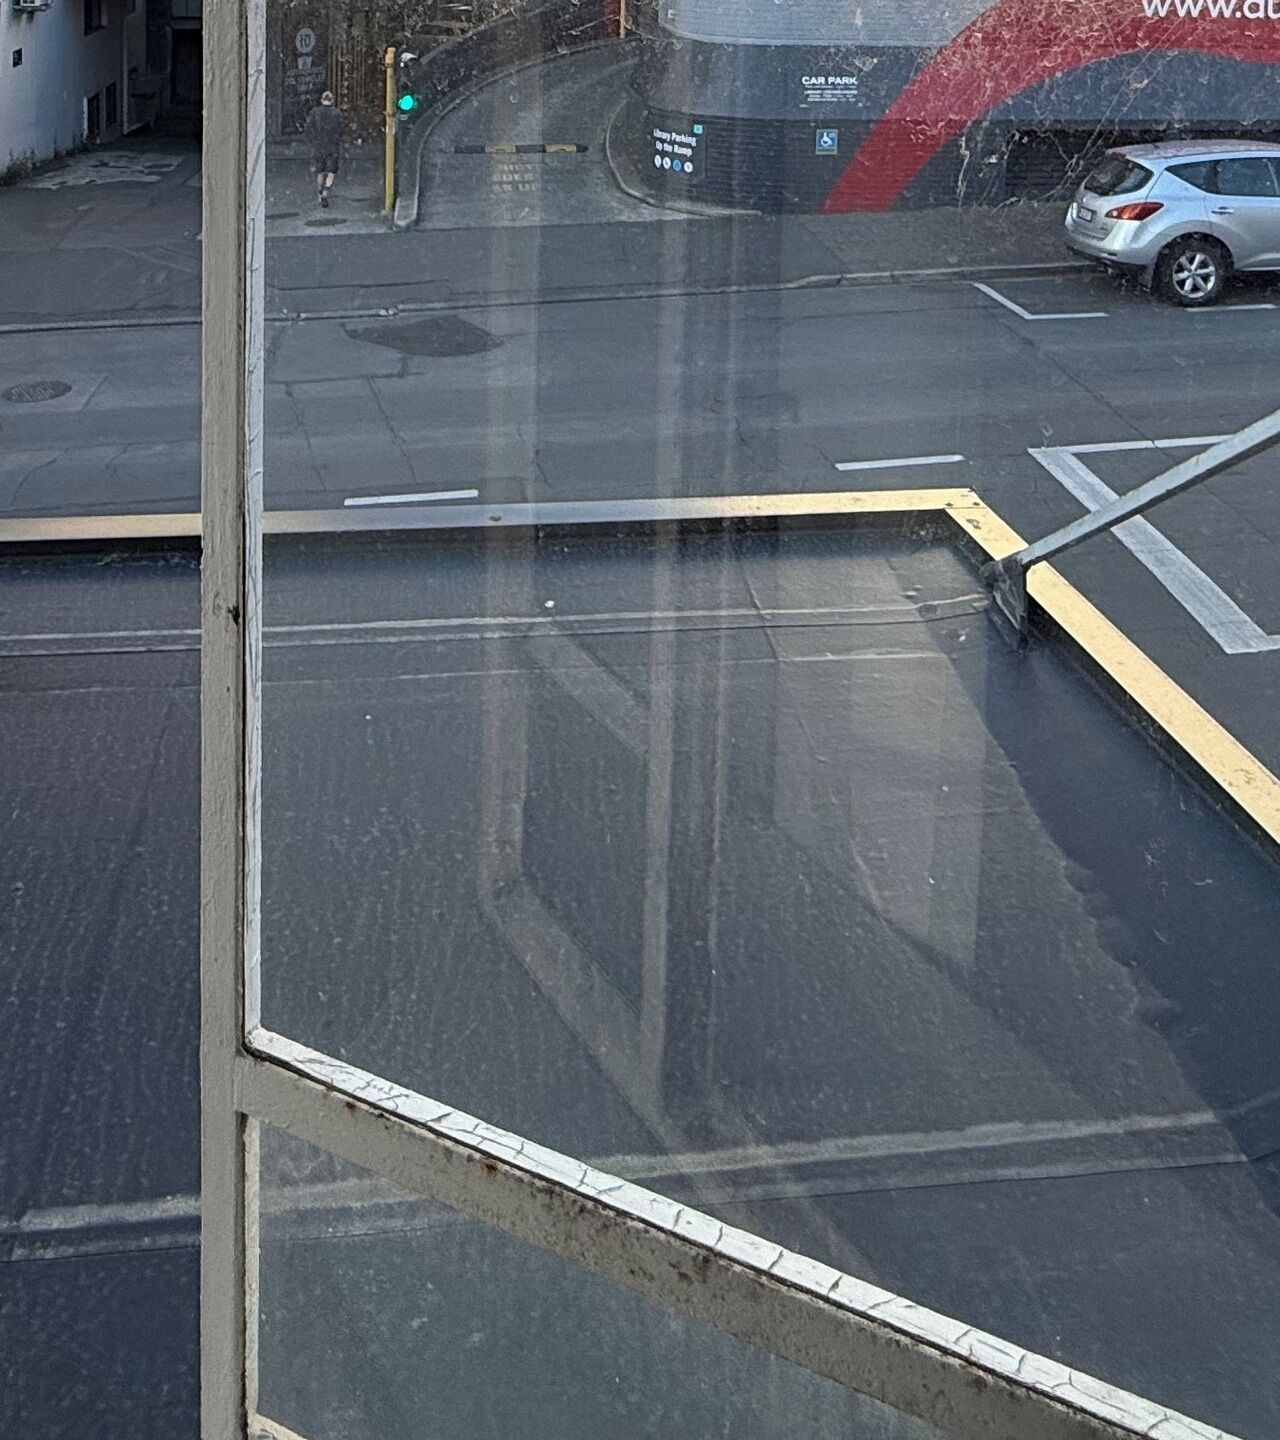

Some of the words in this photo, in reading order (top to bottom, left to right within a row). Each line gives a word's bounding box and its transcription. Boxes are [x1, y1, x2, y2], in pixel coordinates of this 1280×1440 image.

[801, 76, 825, 85] CAR
[827, 76, 858, 85] PARK
[671, 132, 698, 147] Parking
